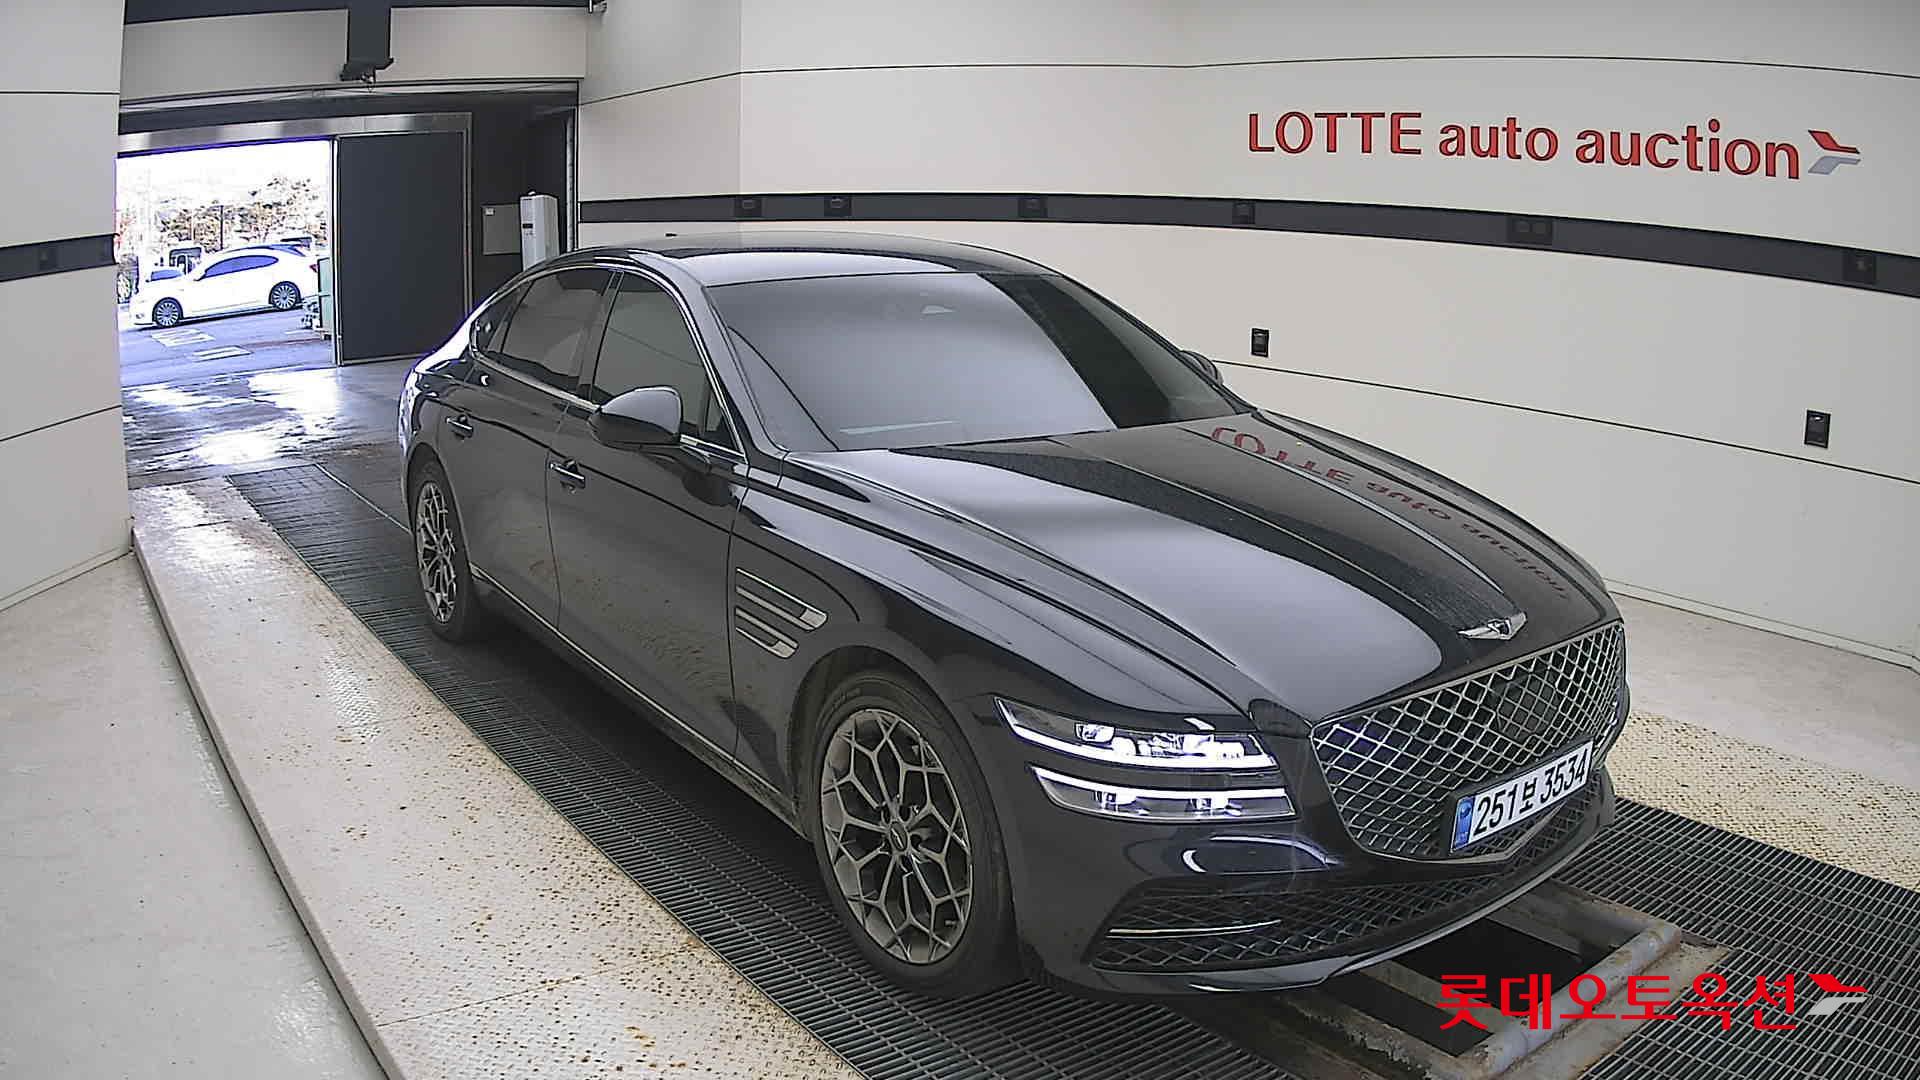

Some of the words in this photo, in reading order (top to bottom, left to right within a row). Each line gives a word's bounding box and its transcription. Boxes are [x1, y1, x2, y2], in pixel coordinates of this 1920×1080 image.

[1248, 111, 1422, 155] LOTTE
[1439, 117, 1559, 161] auto
[1575, 118, 1800, 180] auction
[1540, 748, 1588, 804] 3534
